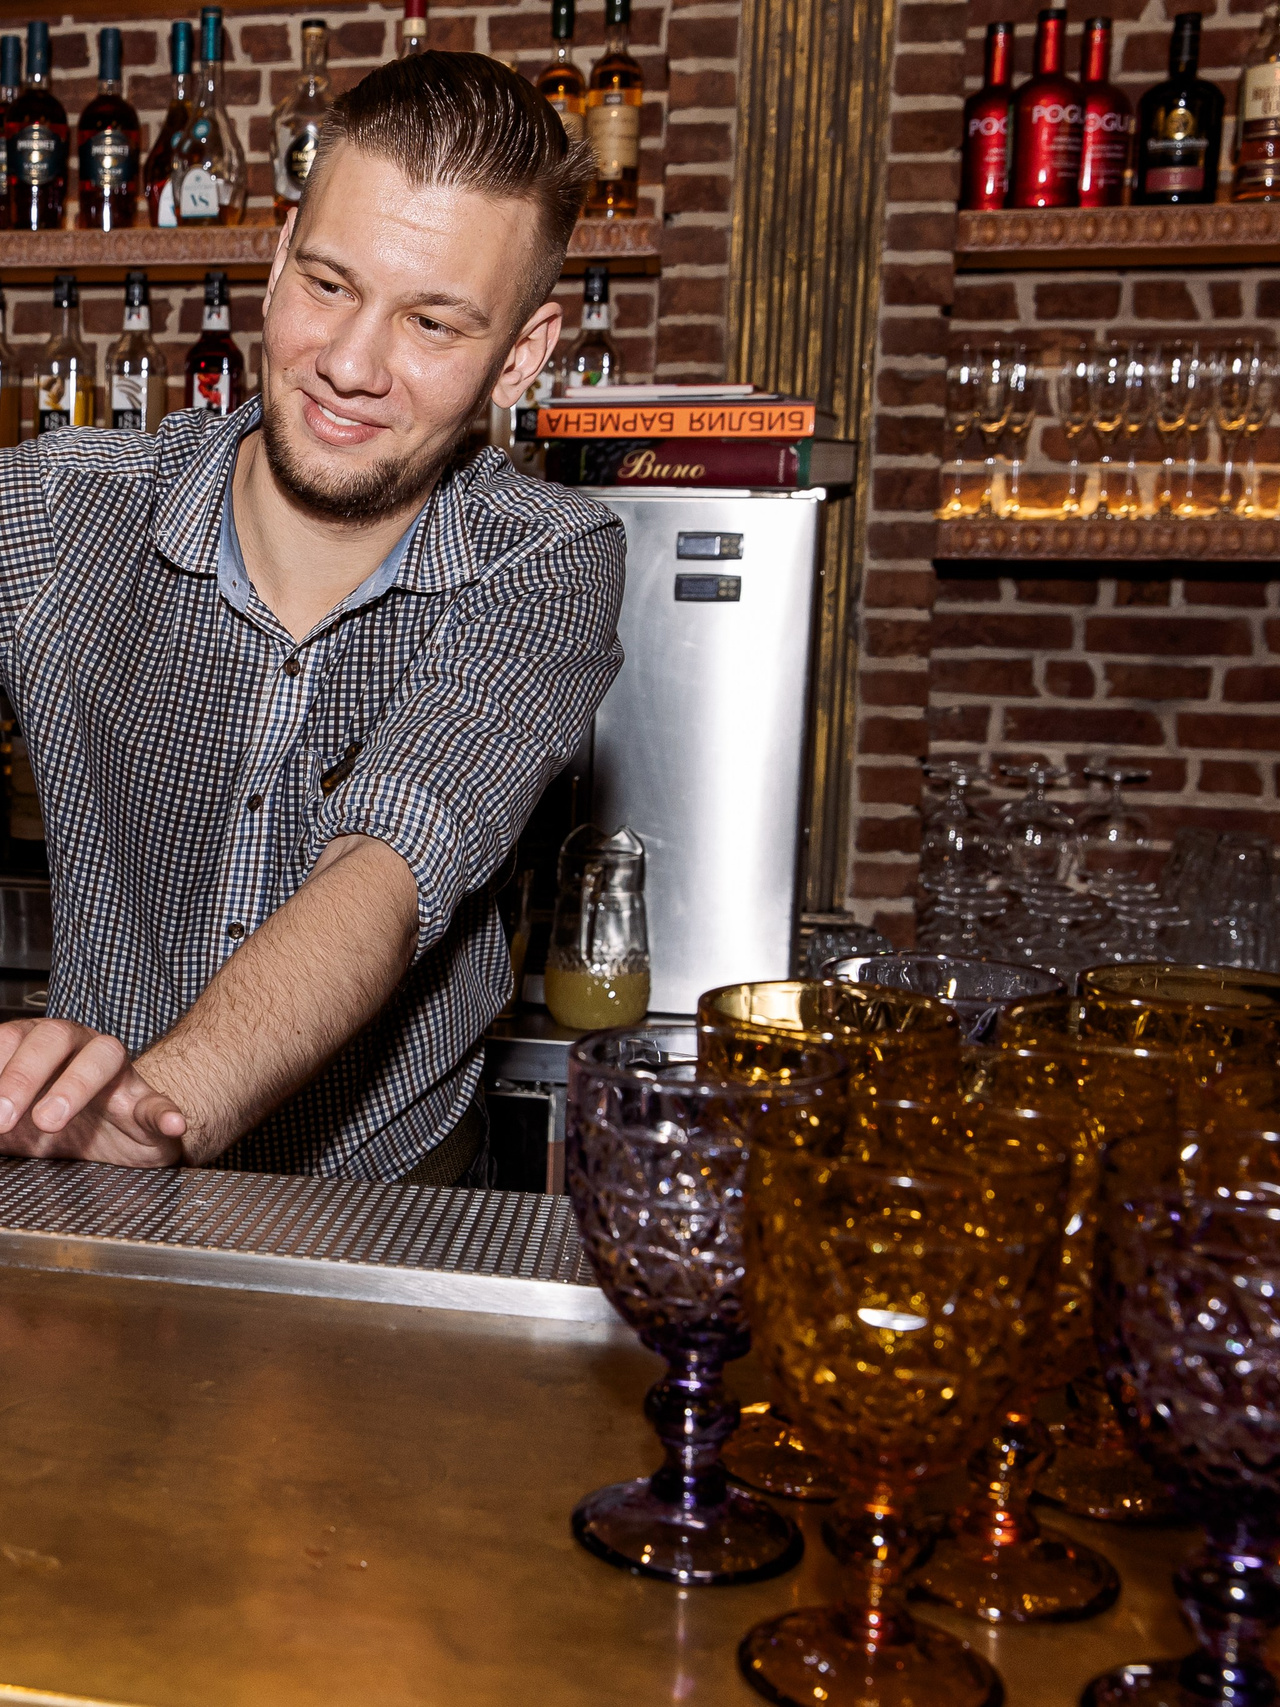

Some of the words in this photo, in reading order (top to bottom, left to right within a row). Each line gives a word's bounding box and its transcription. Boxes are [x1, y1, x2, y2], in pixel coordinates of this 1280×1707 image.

[521, 411, 538, 431] 188
[546, 412, 674, 433] БАРМЕНА
[689, 410, 805, 432] БИБЛИЯ
